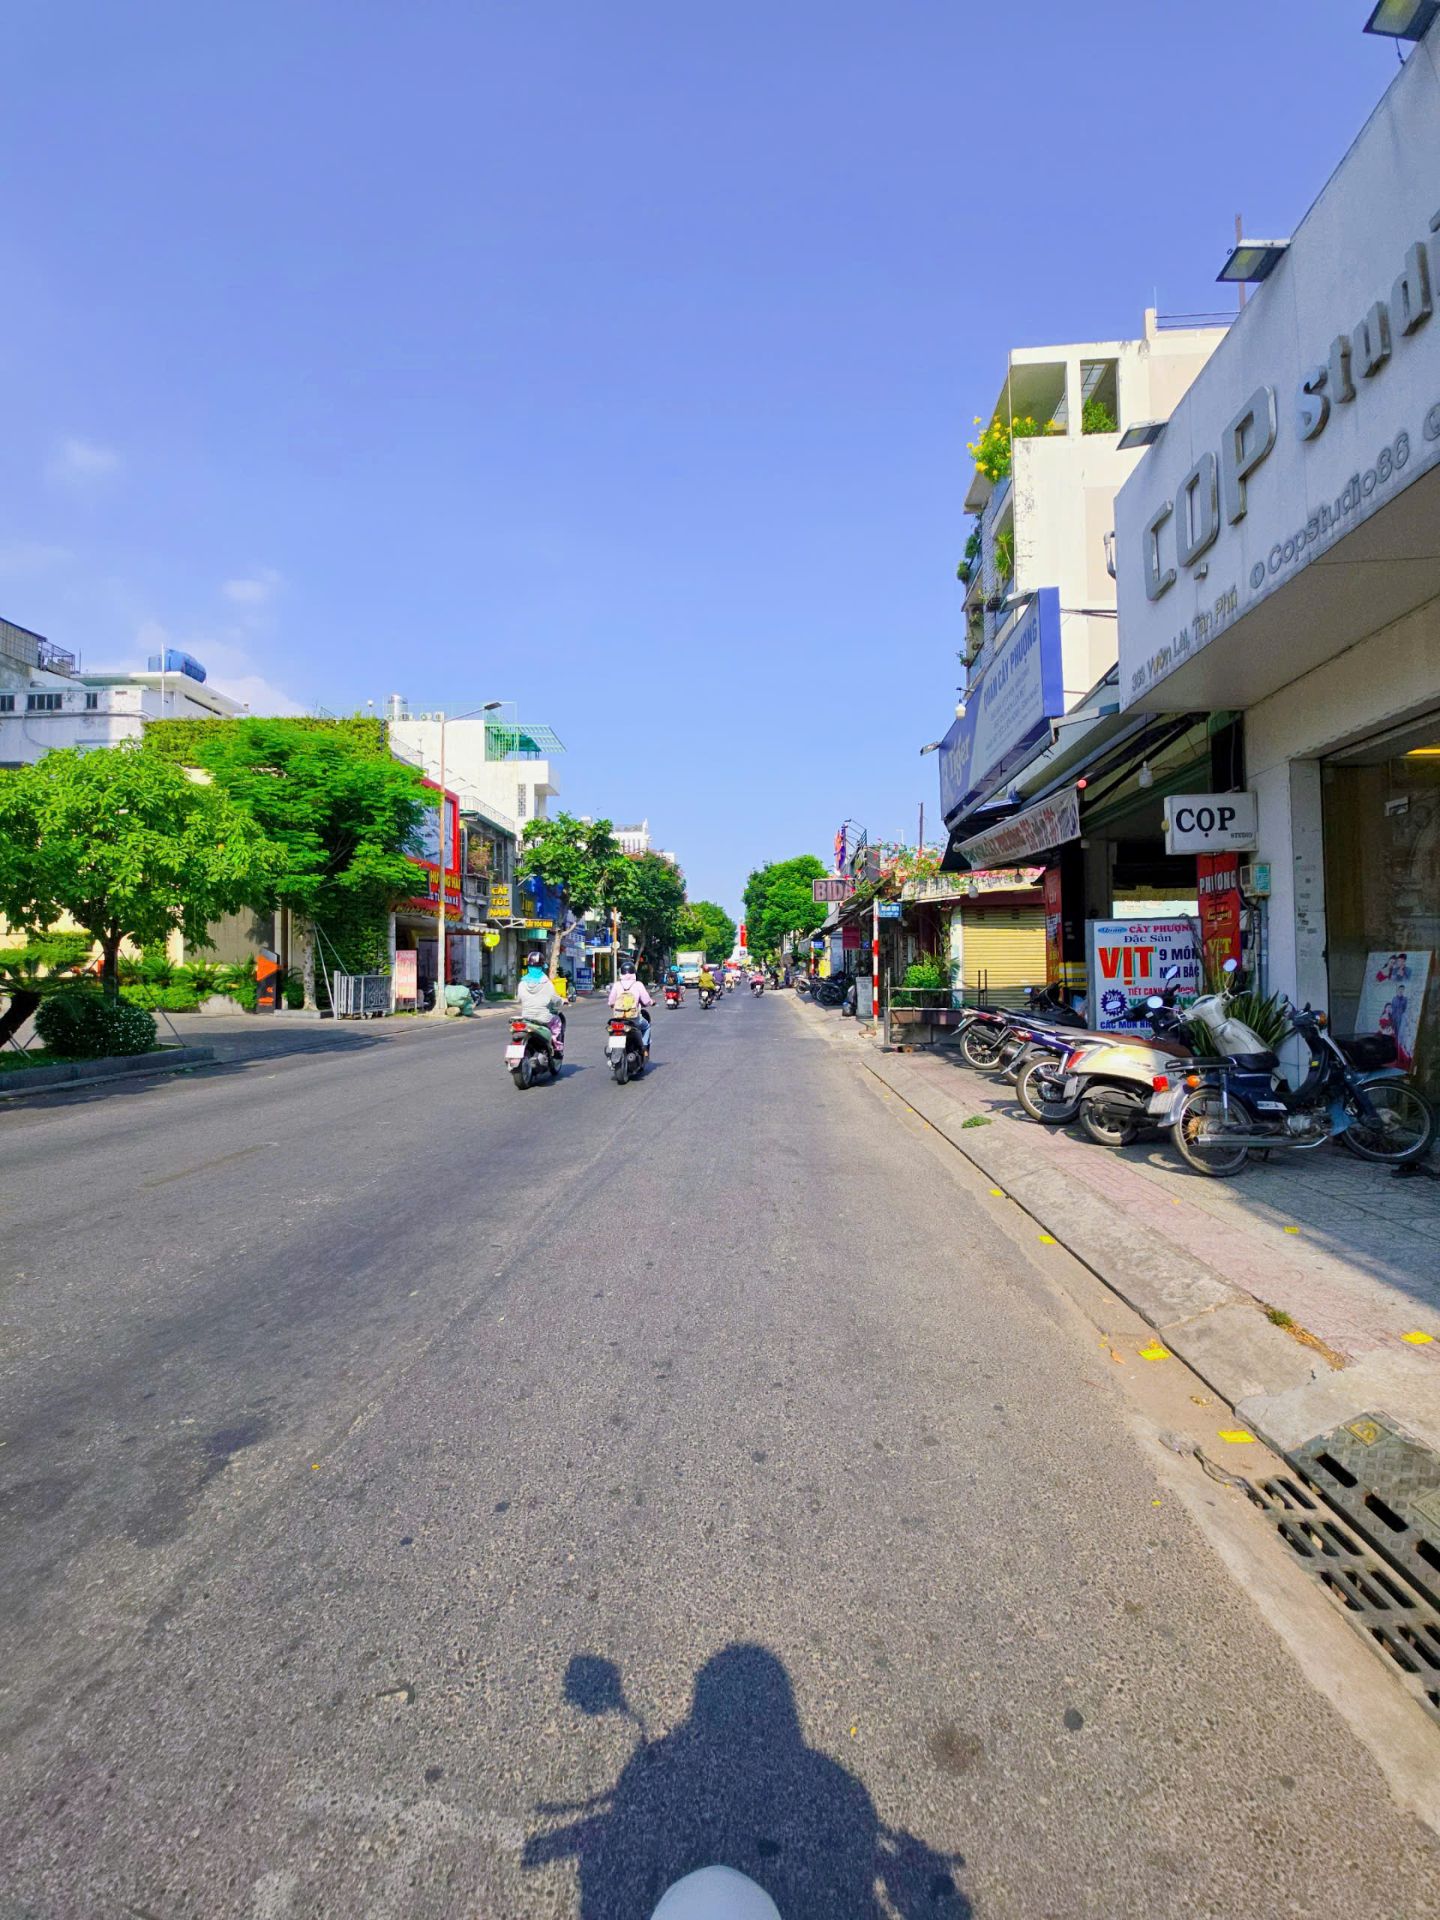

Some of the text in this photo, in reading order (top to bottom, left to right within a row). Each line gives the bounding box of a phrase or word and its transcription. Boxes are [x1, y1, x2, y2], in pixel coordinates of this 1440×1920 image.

[1142, 384, 1278, 602] CỌP
[1176, 807, 1235, 837] CỌP
[1124, 934, 1172, 944] Đặc Sản
[1098, 946, 1158, 986] VỊT
[1159, 949, 1168, 961] 9
